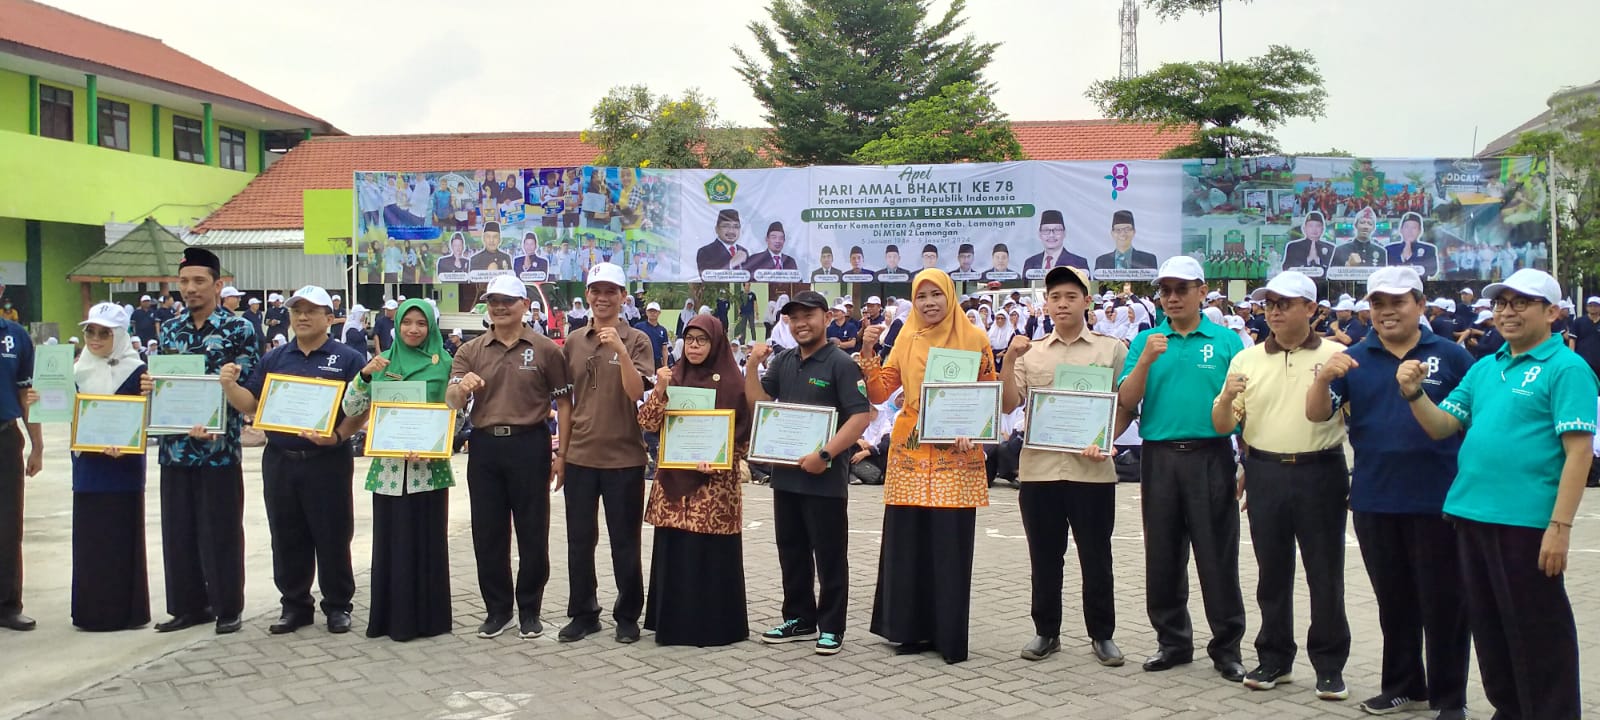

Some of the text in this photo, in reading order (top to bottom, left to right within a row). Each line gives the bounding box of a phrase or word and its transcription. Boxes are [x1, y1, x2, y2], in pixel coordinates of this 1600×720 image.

[898, 166, 933, 184] Apel
[818, 180, 1014, 196] HARI AMAL BHAKTI KE 78
[818, 193, 1015, 205] Kementerian Agama Republik Indonesia
[811, 206, 1023, 218] INDONESIA HEBAT BERSAMA UMAT
[817, 222, 847, 230] Kantor
[909, 221, 941, 229] Agama
[944, 220, 965, 228] Kab.
[968, 219, 1016, 228] Lamongan
[915, 229, 958, 238] Lamongan
